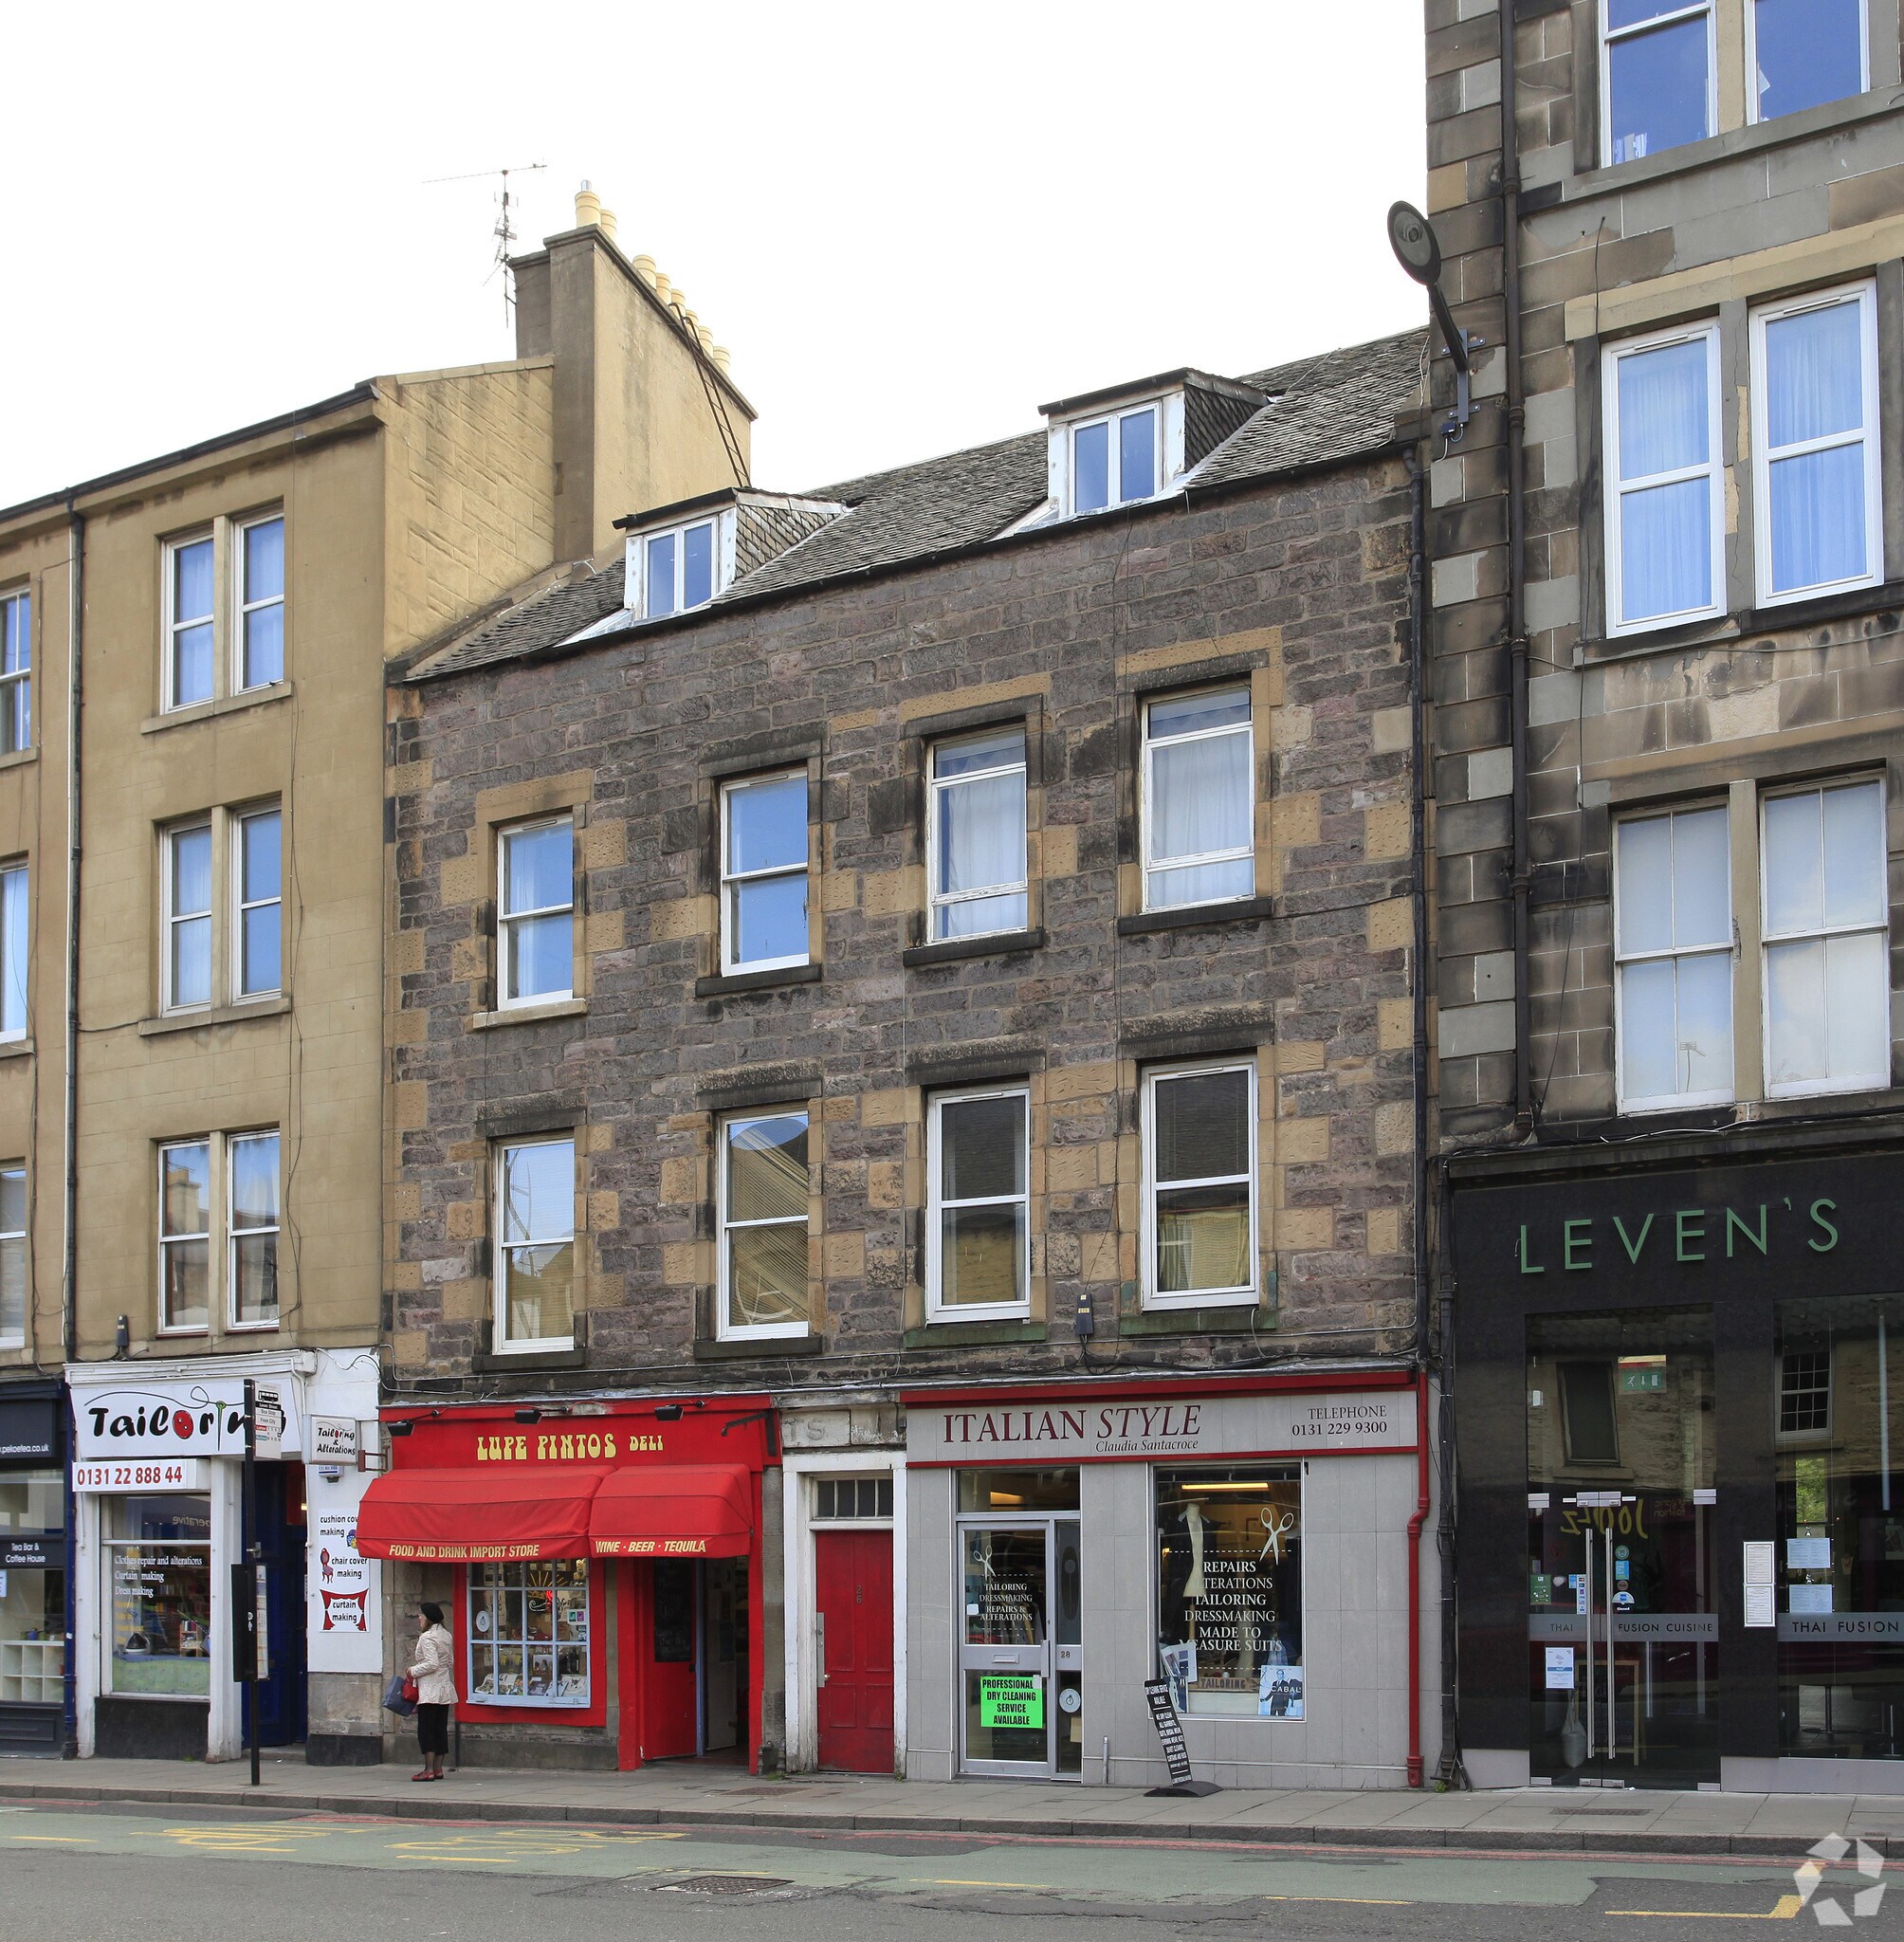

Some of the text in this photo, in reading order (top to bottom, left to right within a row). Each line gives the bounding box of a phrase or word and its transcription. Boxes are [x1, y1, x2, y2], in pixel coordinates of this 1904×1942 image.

[1520, 1197, 1839, 1273] LEVEN'S
[1308, 1405, 1387, 1420] TELEPHONE
[88, 1403, 286, 1447] Tailorin
[943, 1404, 1201, 1443] ITALIAN STYLE
[1291, 1421, 1387, 1437] 0131 229 9300
[318, 1427, 355, 1440] Tailoring
[317, 1443, 356, 1456] Alterations
[477, 1433, 664, 1461] LUPE PINTOS DELI
[1095, 1438, 1199, 1453] Claudia Santacroce
[78, 1466, 182, 1485] 0131 22 888 44
[320, 1515, 346, 1524] cushion
[320, 1528, 344, 1538] making
[11, 1543, 22, 1551] Tea
[24, 1543, 33, 1551] Bar
[389, 1544, 540, 1558] FOOD AND DRINK IMPORT STORE
[595, 1540, 706, 1553] WINE BEER TEQUILA
[6, 1554, 46, 1563] Coffee House
[115, 1555, 202, 1567] Clothes repair and alterations
[1202, 1561, 1256, 1572] REPAIRS
[115, 1570, 164, 1583] Curtain making
[337, 1569, 362, 1580] making
[984, 1583, 1028, 1591] TAILORING
[1199, 1577, 1273, 1589] TERATIONS
[115, 1585, 154, 1598] Dress making
[332, 1600, 357, 1609] curtain
[979, 1594, 1033, 1603] DRESSMAKING
[1195, 1594, 1267, 1605] TAILORING
[332, 1613, 357, 1623] making
[1184, 1610, 1276, 1622] DRESSMAKING
[1199, 1626, 1261, 1639] MADE TO
[1549, 1623, 1713, 1633] THAI FUSION CUISINE
[1792, 1621, 1899, 1633] THAI FUSION
[1244, 1640, 1282, 1651] SUITS
[982, 1679, 1034, 1688] PROFESSIONAL
[1201, 1678, 1246, 1688] TAILORING
[986, 1691, 1036, 1701] DRY CLEANING
[997, 1703, 1026, 1713] SERVICE
[994, 1715, 1030, 1725] AVAILABLE
